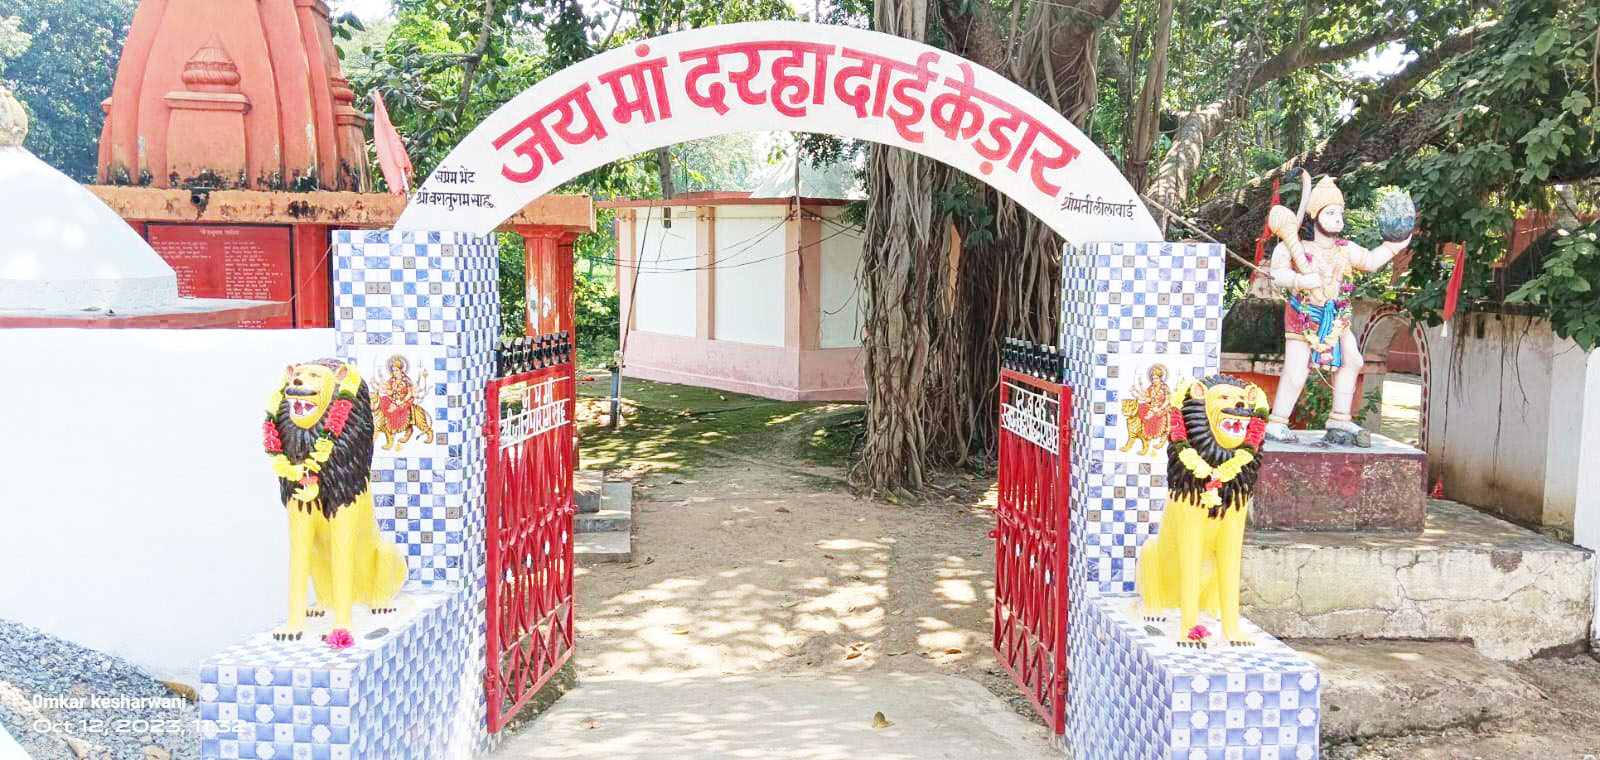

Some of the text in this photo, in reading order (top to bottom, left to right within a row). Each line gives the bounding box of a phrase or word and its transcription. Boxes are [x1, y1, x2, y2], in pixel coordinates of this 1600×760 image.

[492, 82, 608, 184] जय
[679, 40, 836, 118] दरहा
[833, 51, 941, 143] दाई
